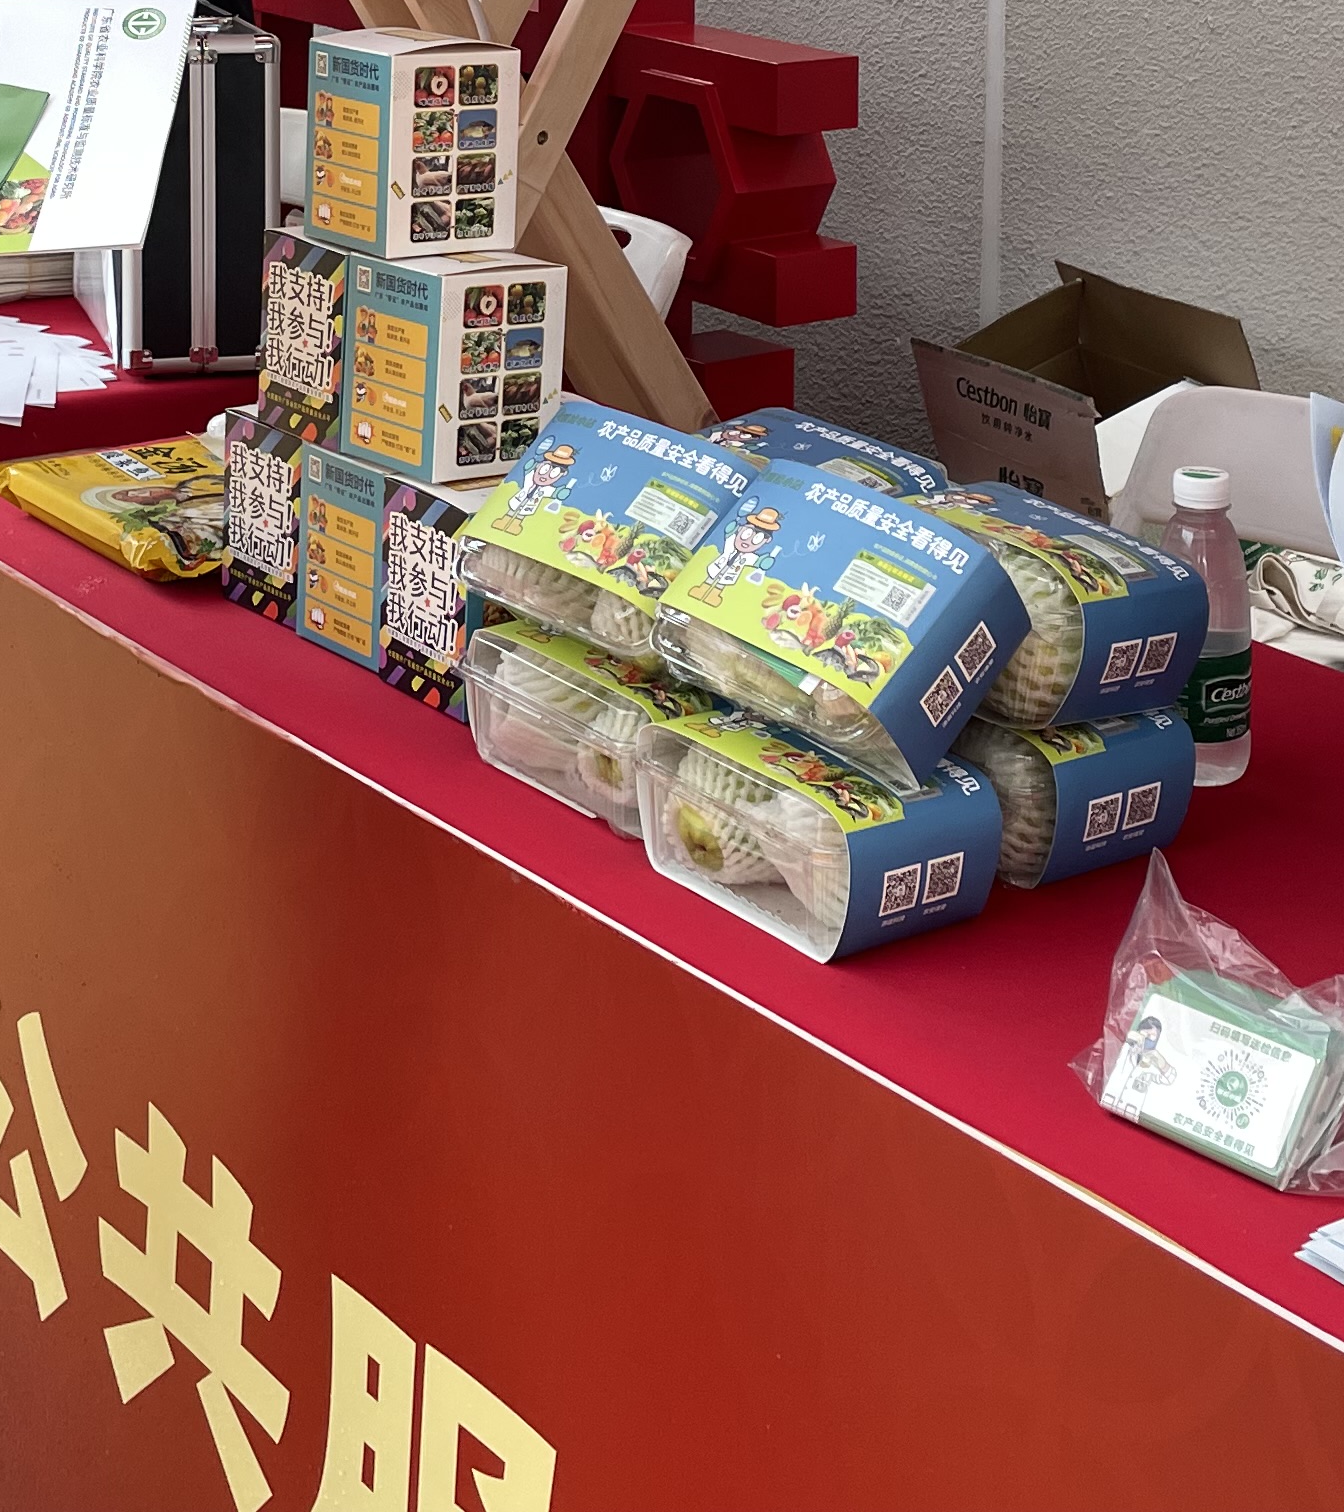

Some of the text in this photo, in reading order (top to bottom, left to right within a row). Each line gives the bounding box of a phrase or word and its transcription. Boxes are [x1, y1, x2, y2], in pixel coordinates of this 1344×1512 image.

[332, 55, 379, 81] 新国货时代
[269, 262, 334, 314] 我支持!
[375, 271, 429, 300] 新国货时代
[267, 302, 334, 352] 我参与!
[266, 337, 333, 387] 我行动!
[956, 377, 1018, 416] C'estbon
[229, 440, 294, 492] 我支持!
[324, 462, 375, 497] 新国货时代
[597, 420, 749, 497] 农产品质量安全看得见
[229, 480, 294, 532] 我参与!
[805, 483, 970, 575] 农产品质量安全看得见
[228, 517, 294, 571] 我行动!
[390, 513, 456, 571] 我支持!
[388, 553, 457, 613] 我参与!
[387, 594, 457, 655] 我行动!
